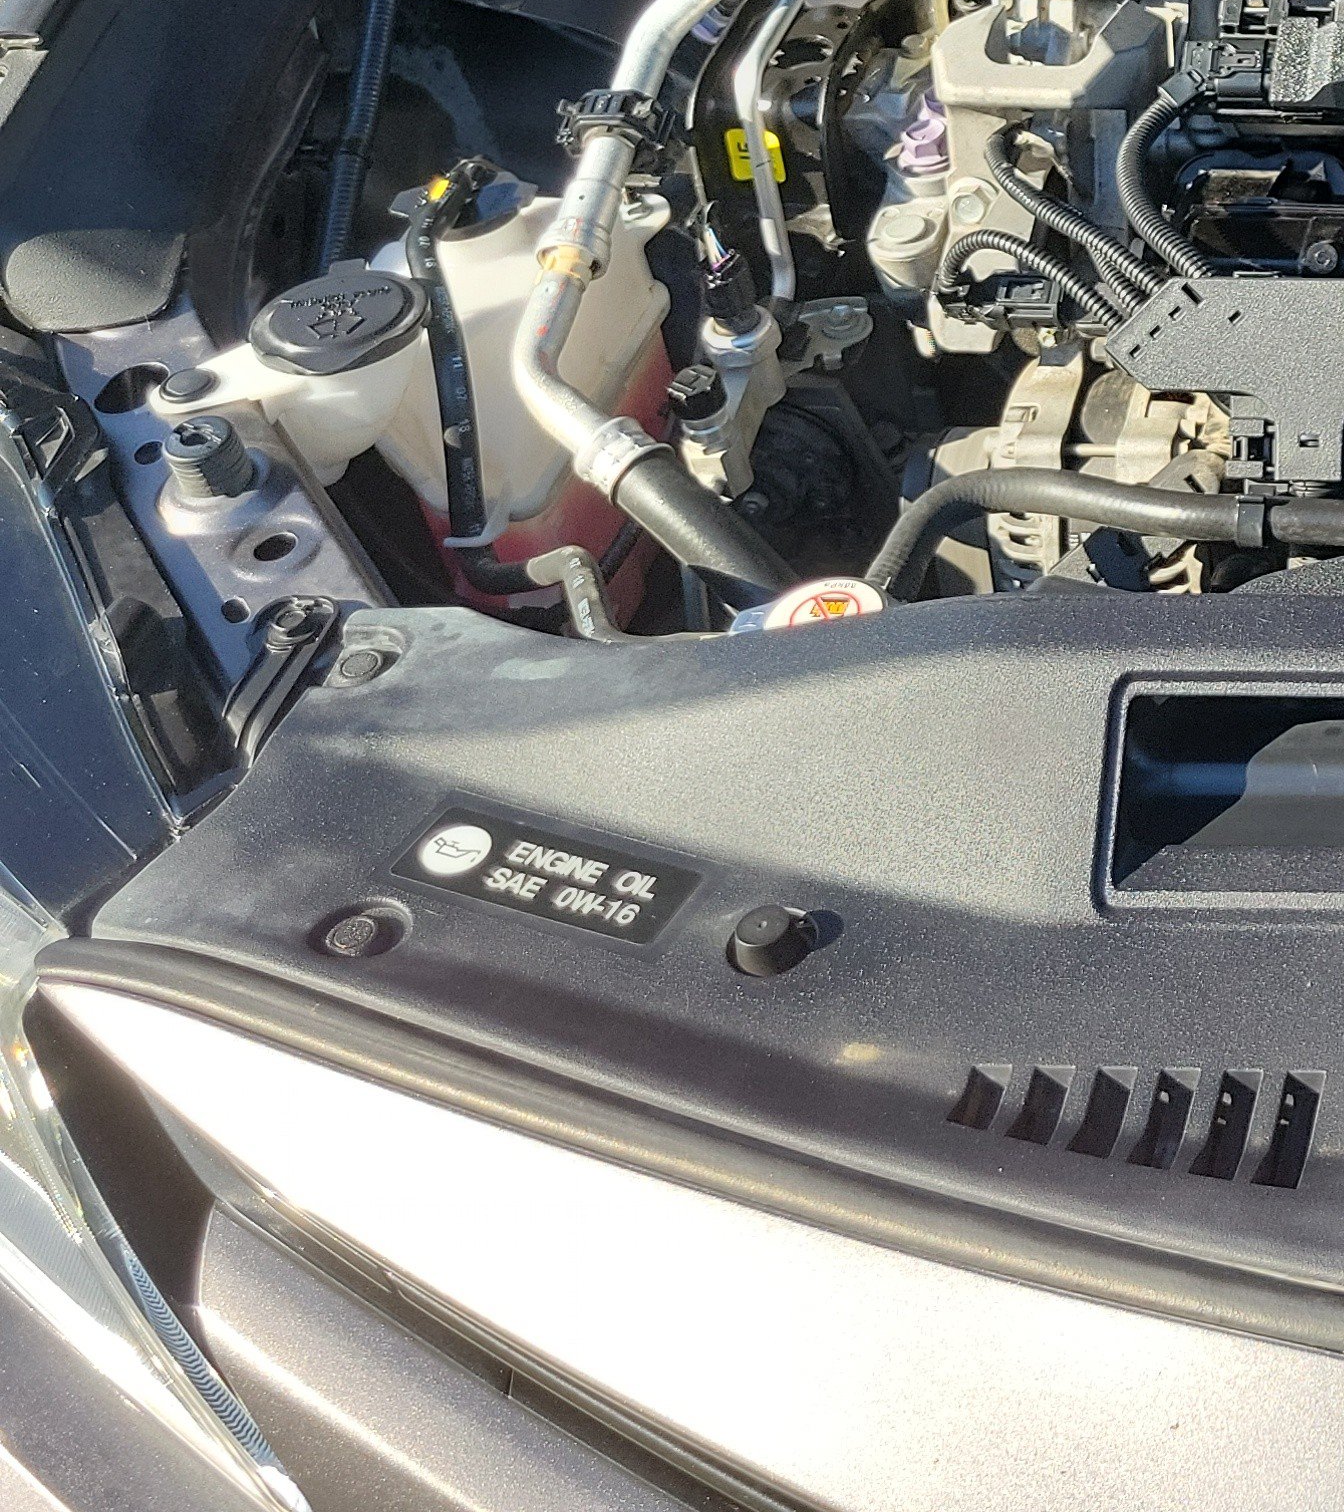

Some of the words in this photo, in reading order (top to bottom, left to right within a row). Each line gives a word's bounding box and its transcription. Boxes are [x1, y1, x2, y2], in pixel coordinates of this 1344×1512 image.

[486, 867, 548, 899] SAE
[554, 886, 640, 926] 0W-16
[506, 840, 609, 884] ENGINE
[613, 871, 658, 899] OIL
